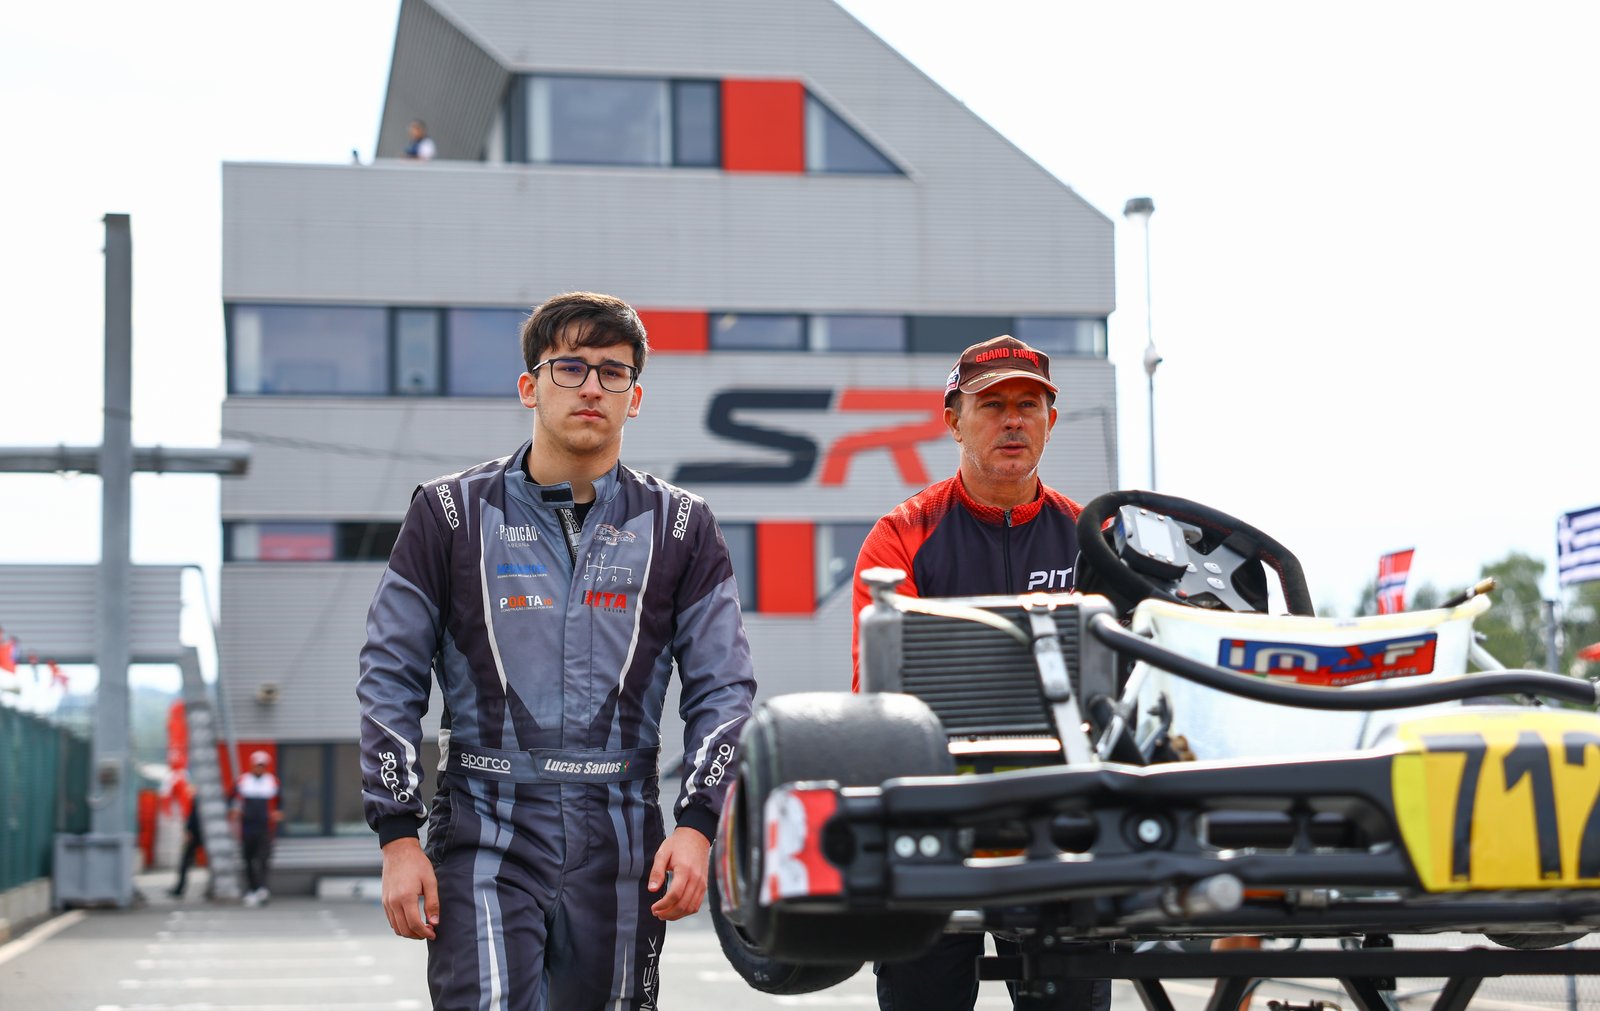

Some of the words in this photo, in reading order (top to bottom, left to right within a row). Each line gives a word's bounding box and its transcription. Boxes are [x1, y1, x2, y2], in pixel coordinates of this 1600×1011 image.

[976, 347, 1010, 364] GRAND
[672, 387, 948, 487] SR
[436, 483, 460, 530] sparco
[672, 496, 693, 541] sparco
[499, 595, 543, 609] PORTA
[460, 751, 511, 774] sparco
[544, 758, 582, 774] Lucas
[583, 761, 622, 775] Santos
